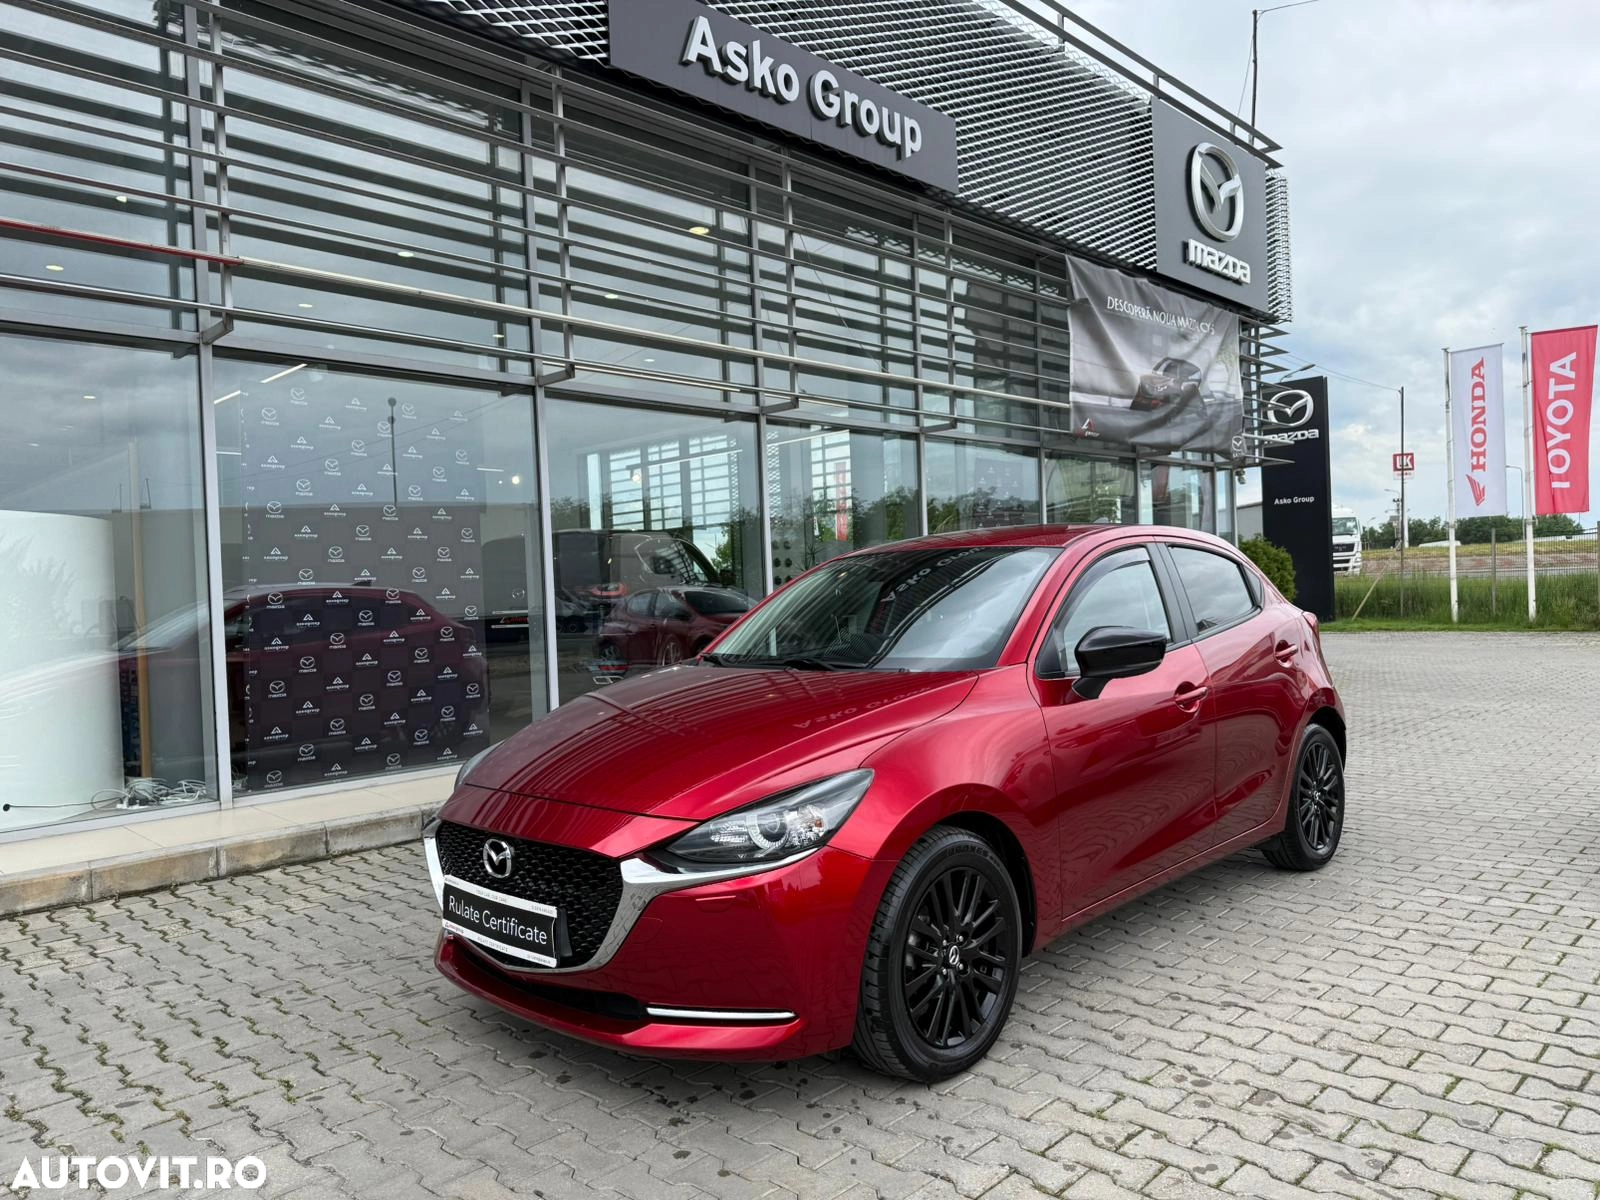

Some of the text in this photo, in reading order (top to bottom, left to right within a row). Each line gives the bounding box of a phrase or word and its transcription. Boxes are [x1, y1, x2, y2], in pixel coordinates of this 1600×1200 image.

[680, 15, 922, 158] Asko Group
[1107, 296, 1152, 321] DESCOPERĂ
[1153, 311, 1176, 327] NOUA
[1470, 356, 1487, 472] HONDA
[1274, 495, 1315, 505] Asko Group
[449, 895, 547, 945] Rulate Certificate
